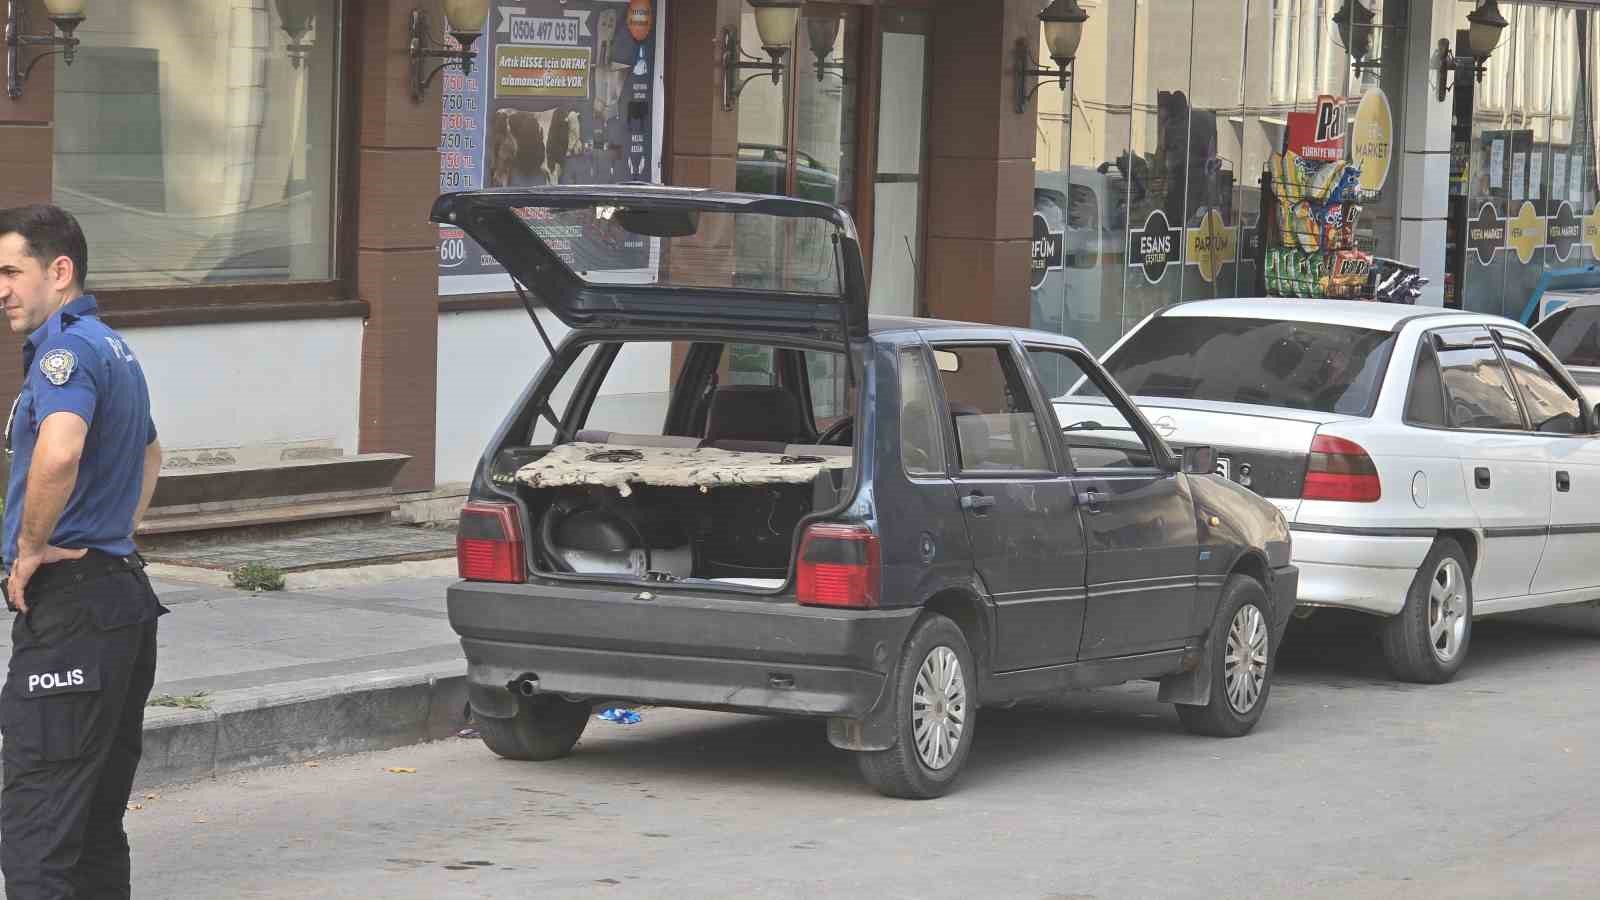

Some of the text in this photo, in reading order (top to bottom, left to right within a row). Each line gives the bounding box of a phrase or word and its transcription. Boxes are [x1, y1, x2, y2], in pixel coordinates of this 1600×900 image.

[512, 20, 577, 42] 0506 497 03 51
[560, 58, 587, 69] ORTAK
[442, 77, 479, 91] 750 TL
[567, 76, 583, 88] YOK
[442, 95, 478, 110] 750 TL
[441, 114, 478, 129] 750 TL
[441, 133, 476, 149] 750 TL
[1355, 143, 1388, 159] MARKET
[440, 153, 475, 168] 750 TL
[440, 172, 473, 187] 750 TL
[1484, 228, 1503, 240] MARKET
[441, 240, 464, 260] 600
[1140, 236, 1171, 254] ESANS
[28, 669, 84, 692] POLIS
